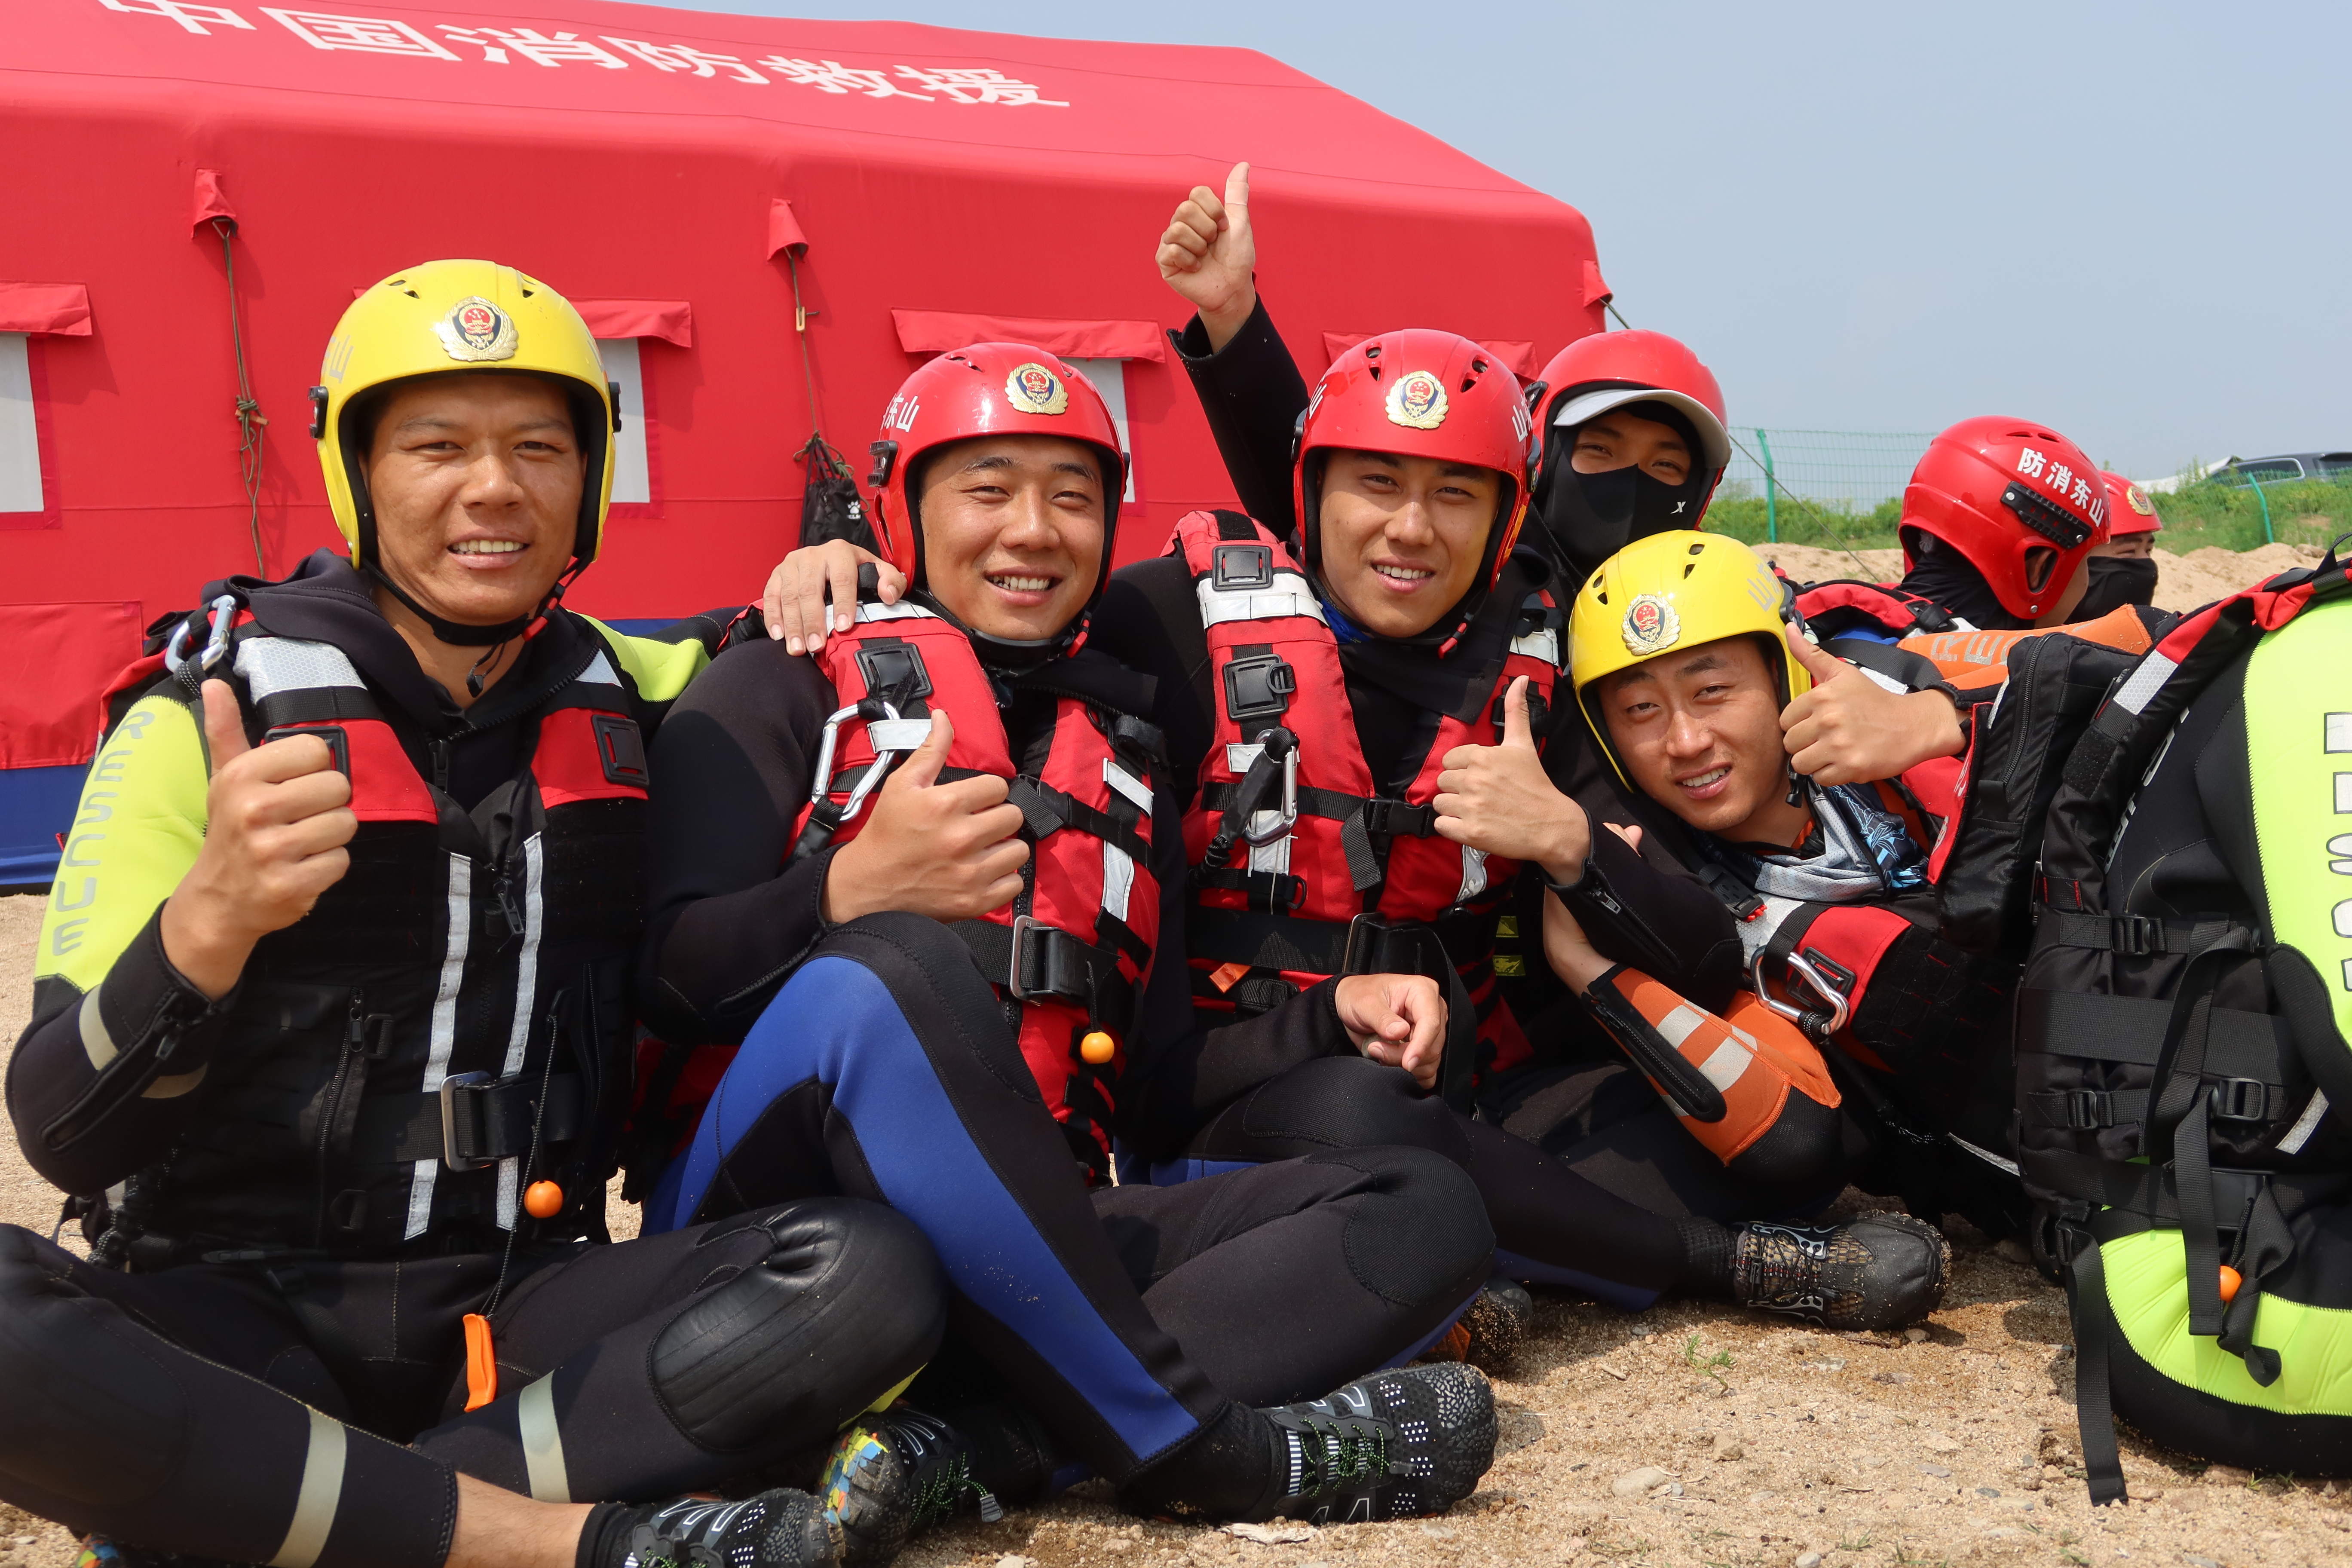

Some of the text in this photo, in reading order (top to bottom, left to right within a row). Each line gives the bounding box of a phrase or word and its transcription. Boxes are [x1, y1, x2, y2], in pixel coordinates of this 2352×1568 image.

[97, 0, 1070, 107] 中国消防救援
[880, 392, 920, 432] 东山
[2017, 447, 2104, 528] 防消东山
[52, 711, 155, 956] RESCUE
